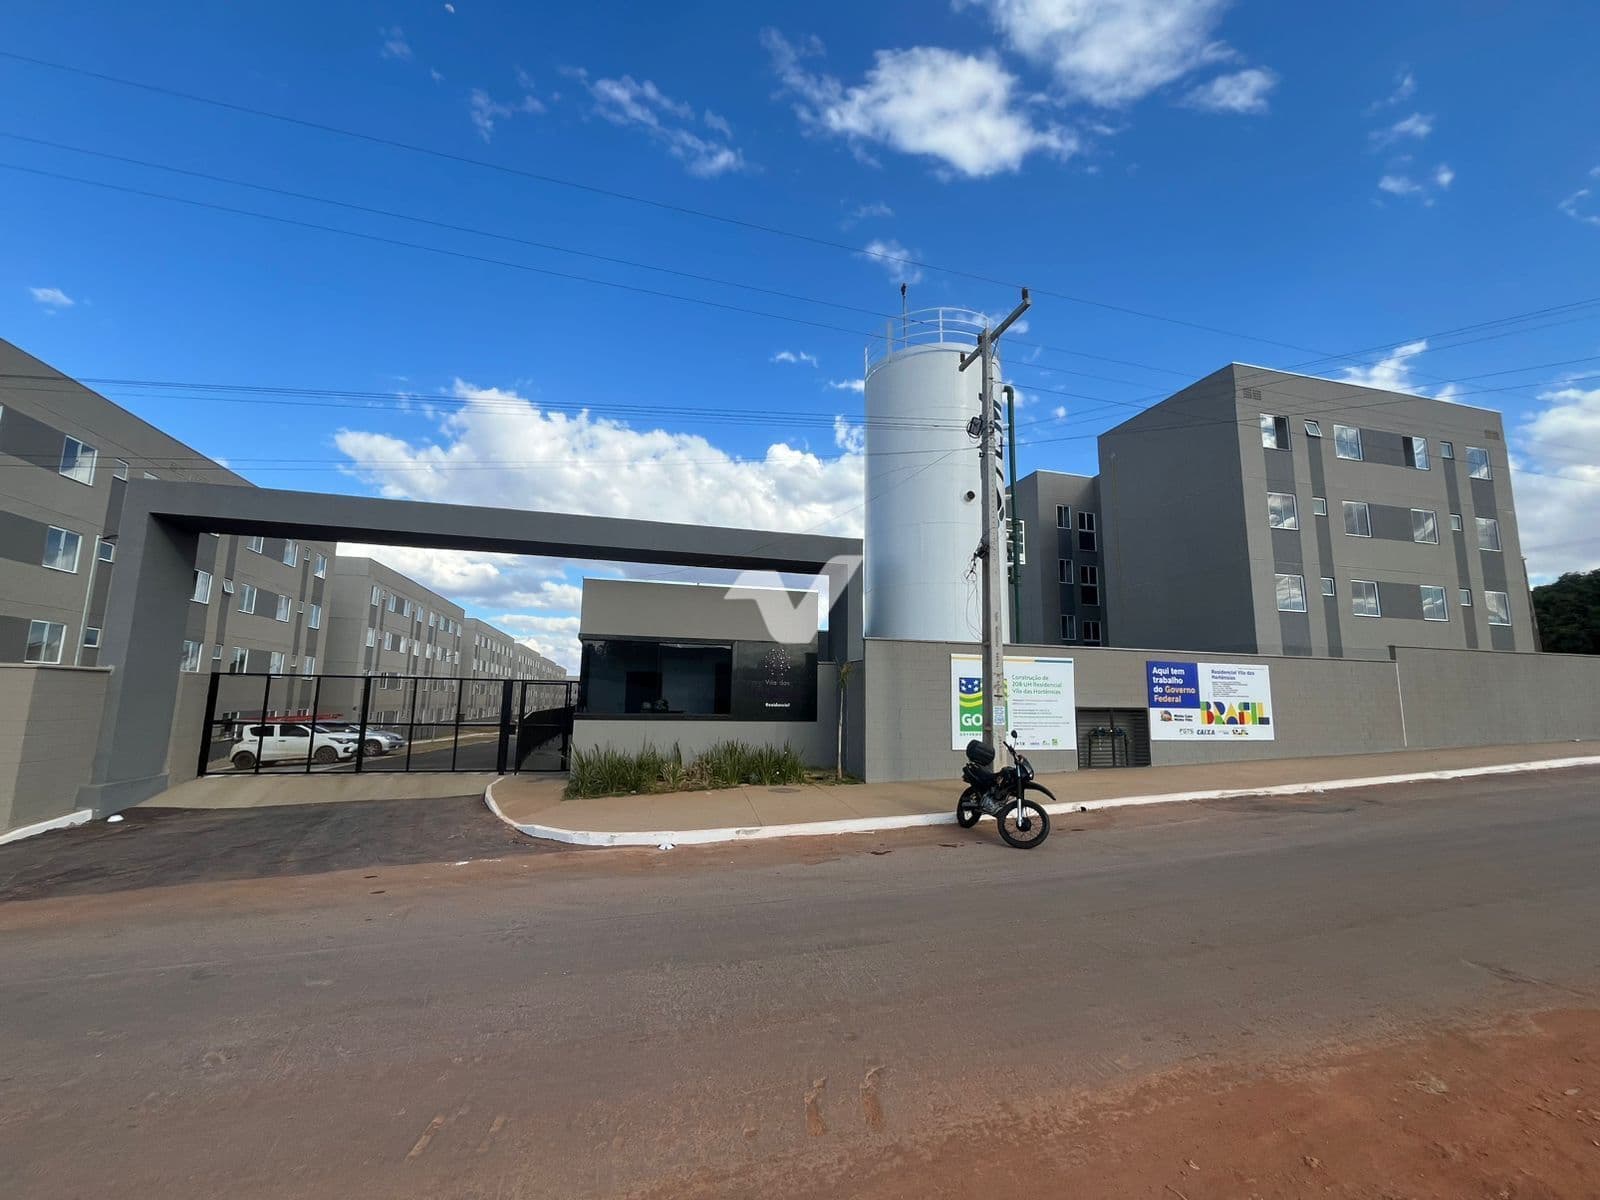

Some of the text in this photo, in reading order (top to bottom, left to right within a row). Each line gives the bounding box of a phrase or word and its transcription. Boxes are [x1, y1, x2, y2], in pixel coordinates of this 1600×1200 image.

[1152, 667, 1170, 676] Aqui
[1153, 676, 1183, 684] trabalho
[1201, 701, 1270, 725] BRASIL
